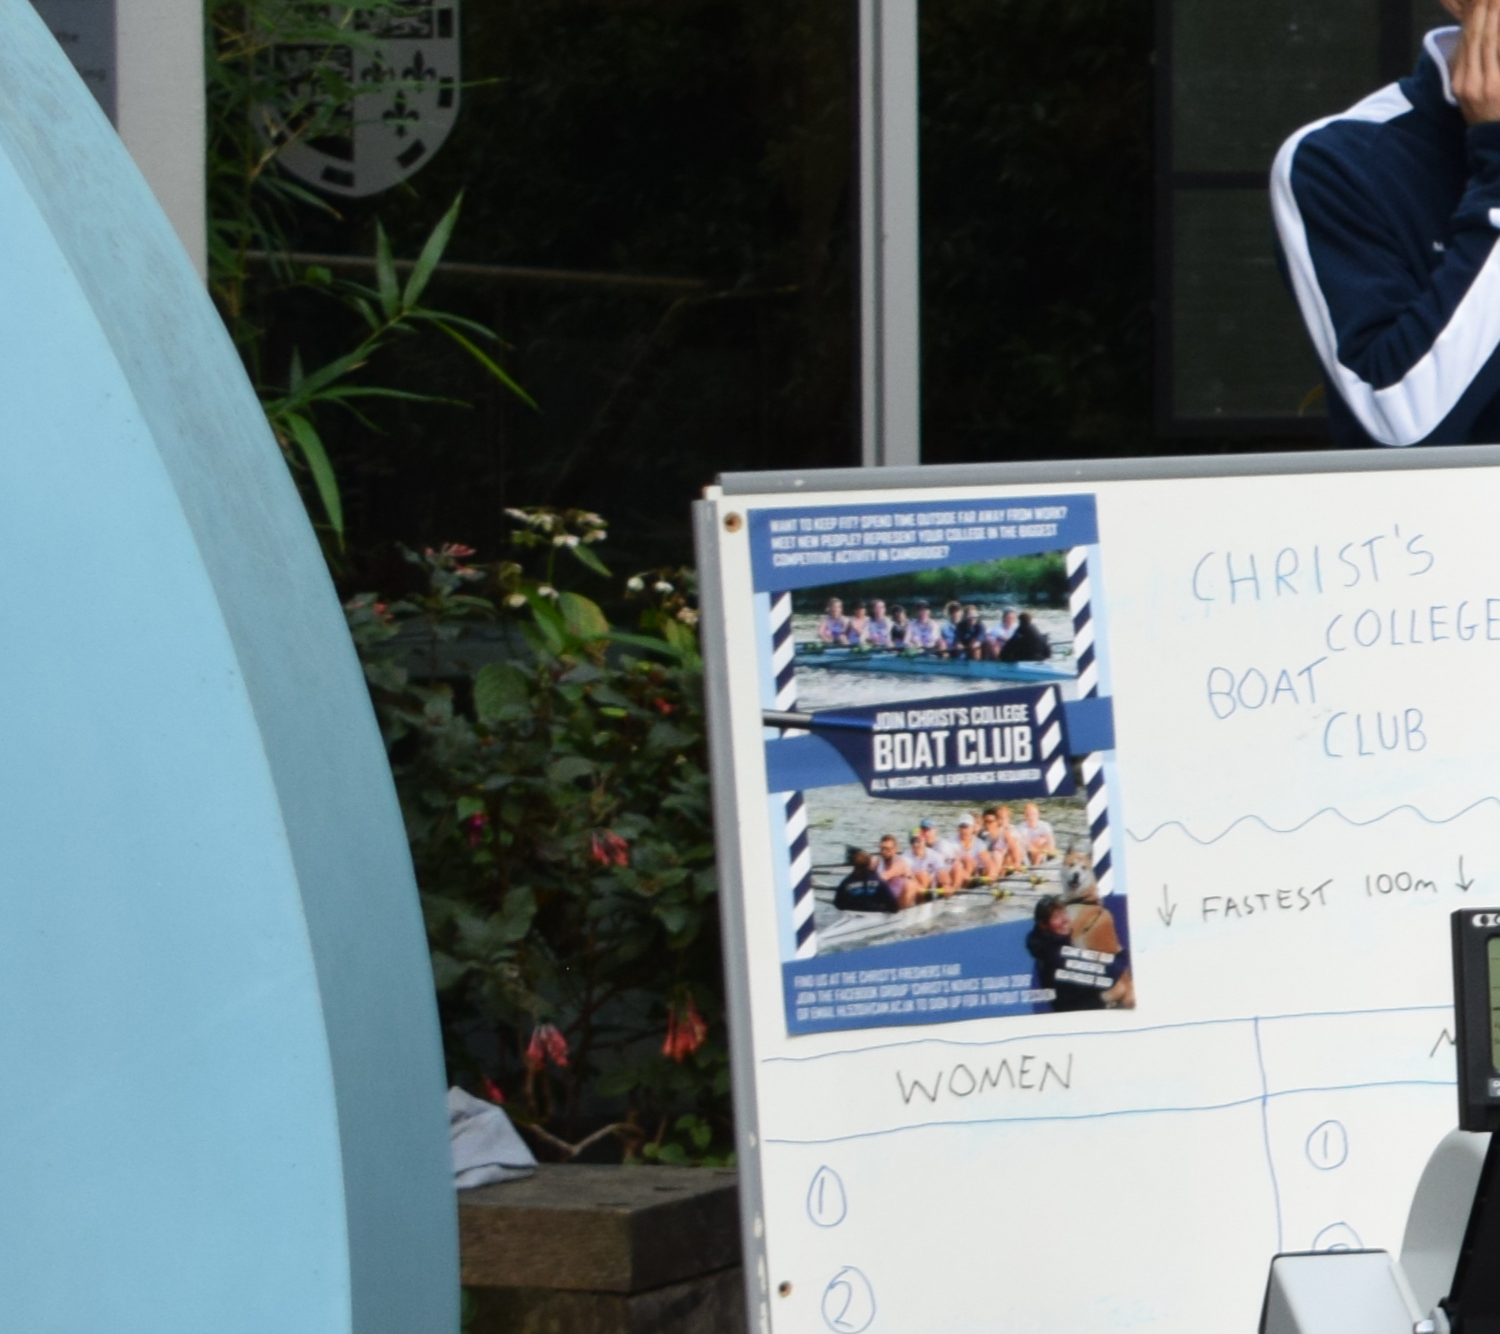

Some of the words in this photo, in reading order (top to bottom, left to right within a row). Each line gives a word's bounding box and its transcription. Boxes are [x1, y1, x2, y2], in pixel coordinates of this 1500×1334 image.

[1192, 523, 1435, 603] CHRIST'S
[1206, 657, 1327, 719] BOAT
[873, 711, 905, 730] JOIN
[907, 707, 969, 728] CHRIST'S
[970, 703, 1029, 725] COLLEGE
[1323, 708, 1427, 758] CLUB
[873, 730, 949, 772] BOAT
[957, 725, 1032, 766] CLUB
[1202, 879, 1334, 922] FASTEST
[1365, 872, 1437, 898] 100m
[896, 1053, 1073, 1104] WOMEN
